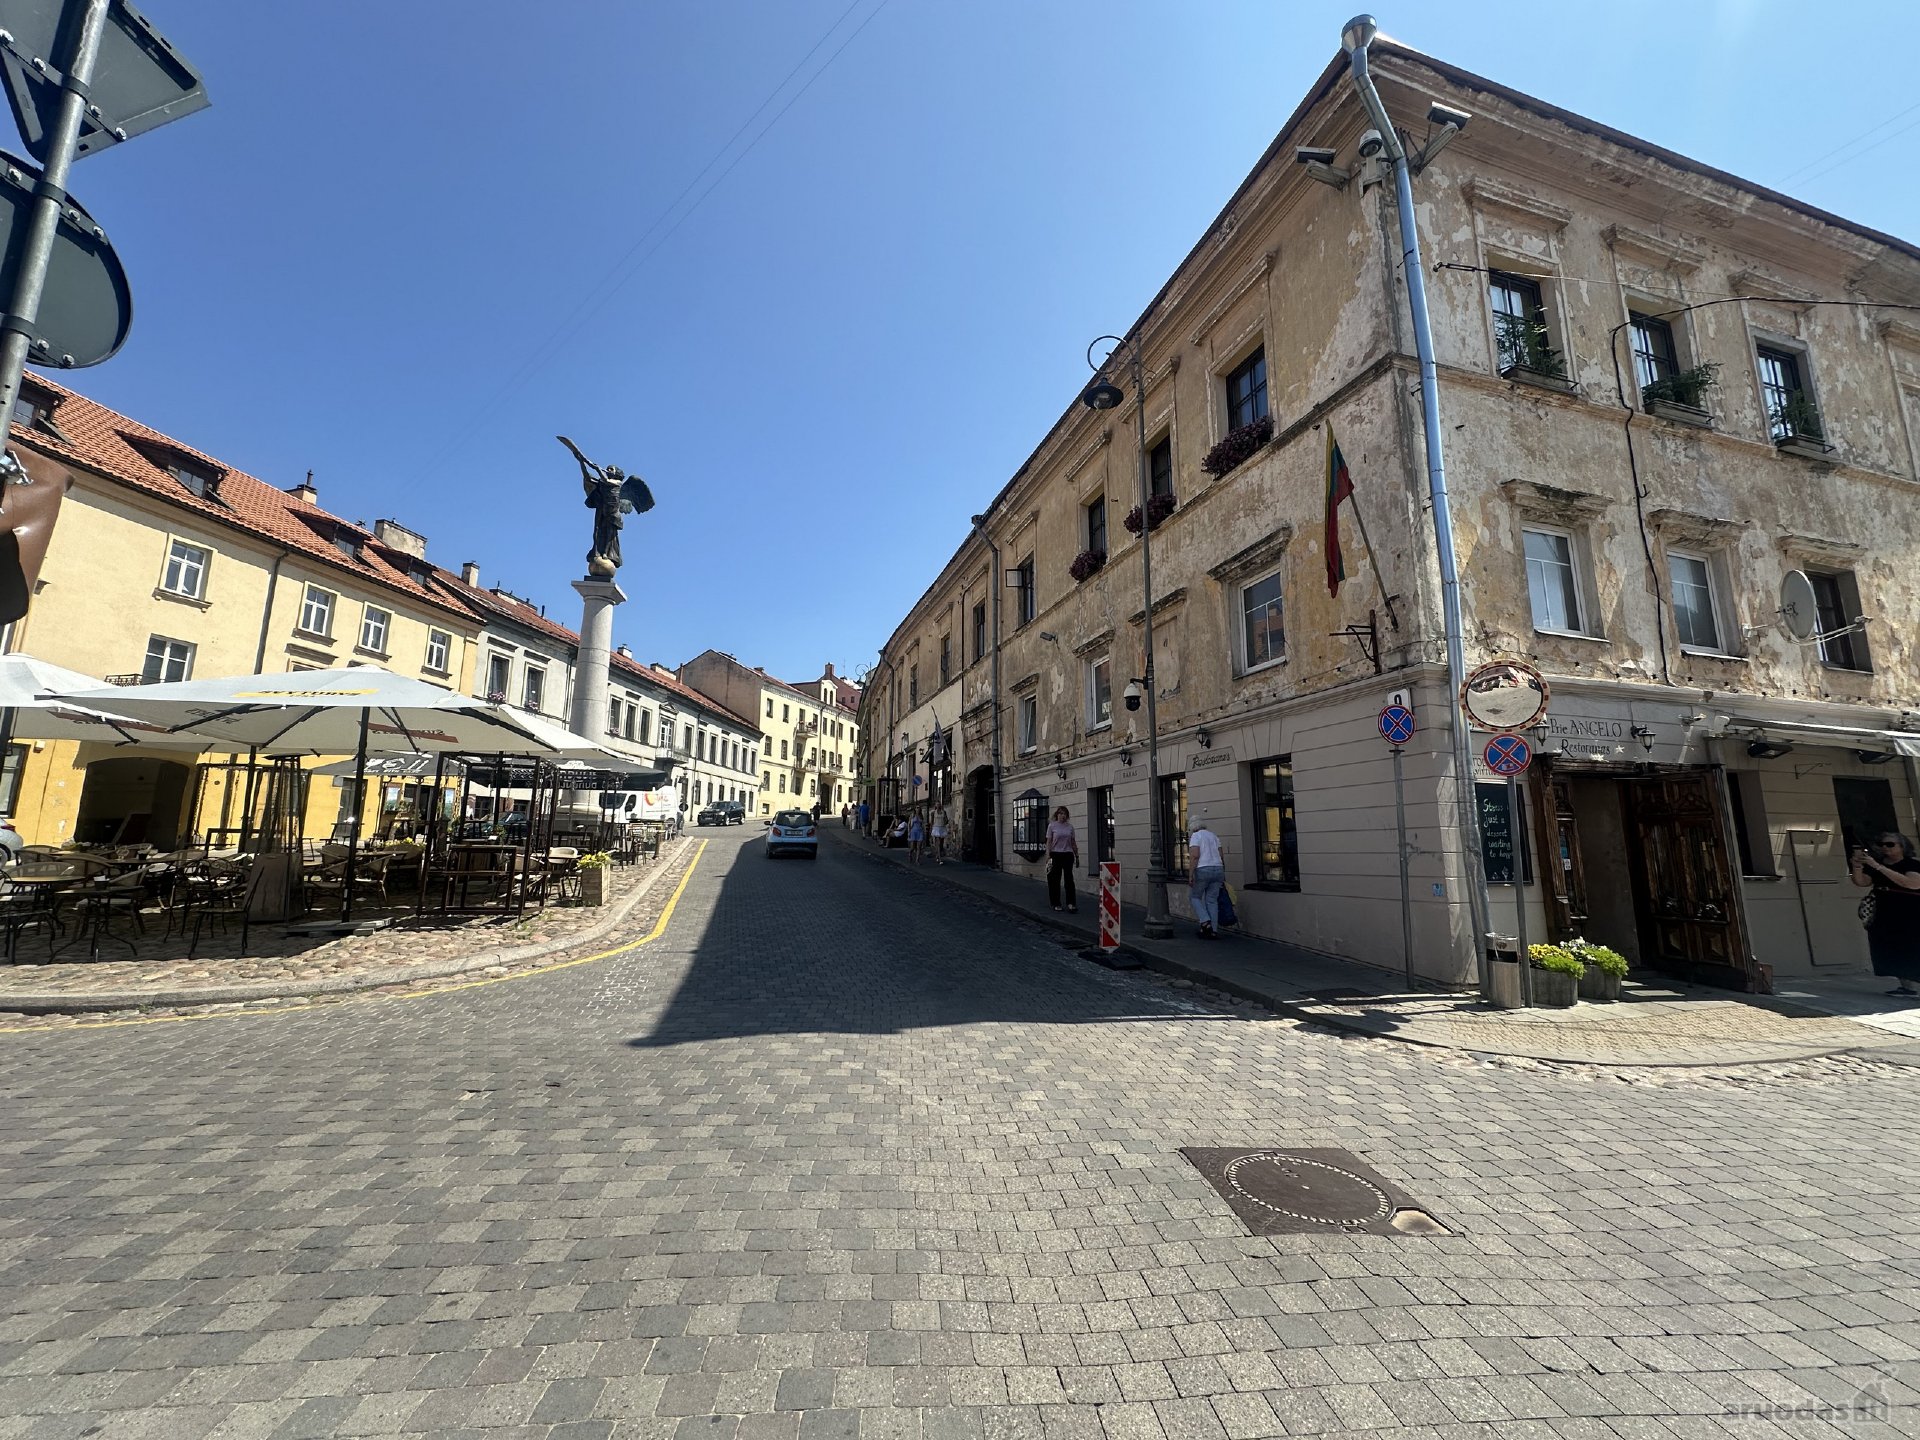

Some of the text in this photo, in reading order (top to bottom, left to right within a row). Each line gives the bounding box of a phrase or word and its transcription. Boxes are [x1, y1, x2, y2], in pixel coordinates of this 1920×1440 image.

[1550, 719, 1622, 738] Prie ANGELO
[1561, 738, 1611, 757] Restoranas
[1483, 813, 1499, 828] just
[1489, 849, 1497, 858] to
